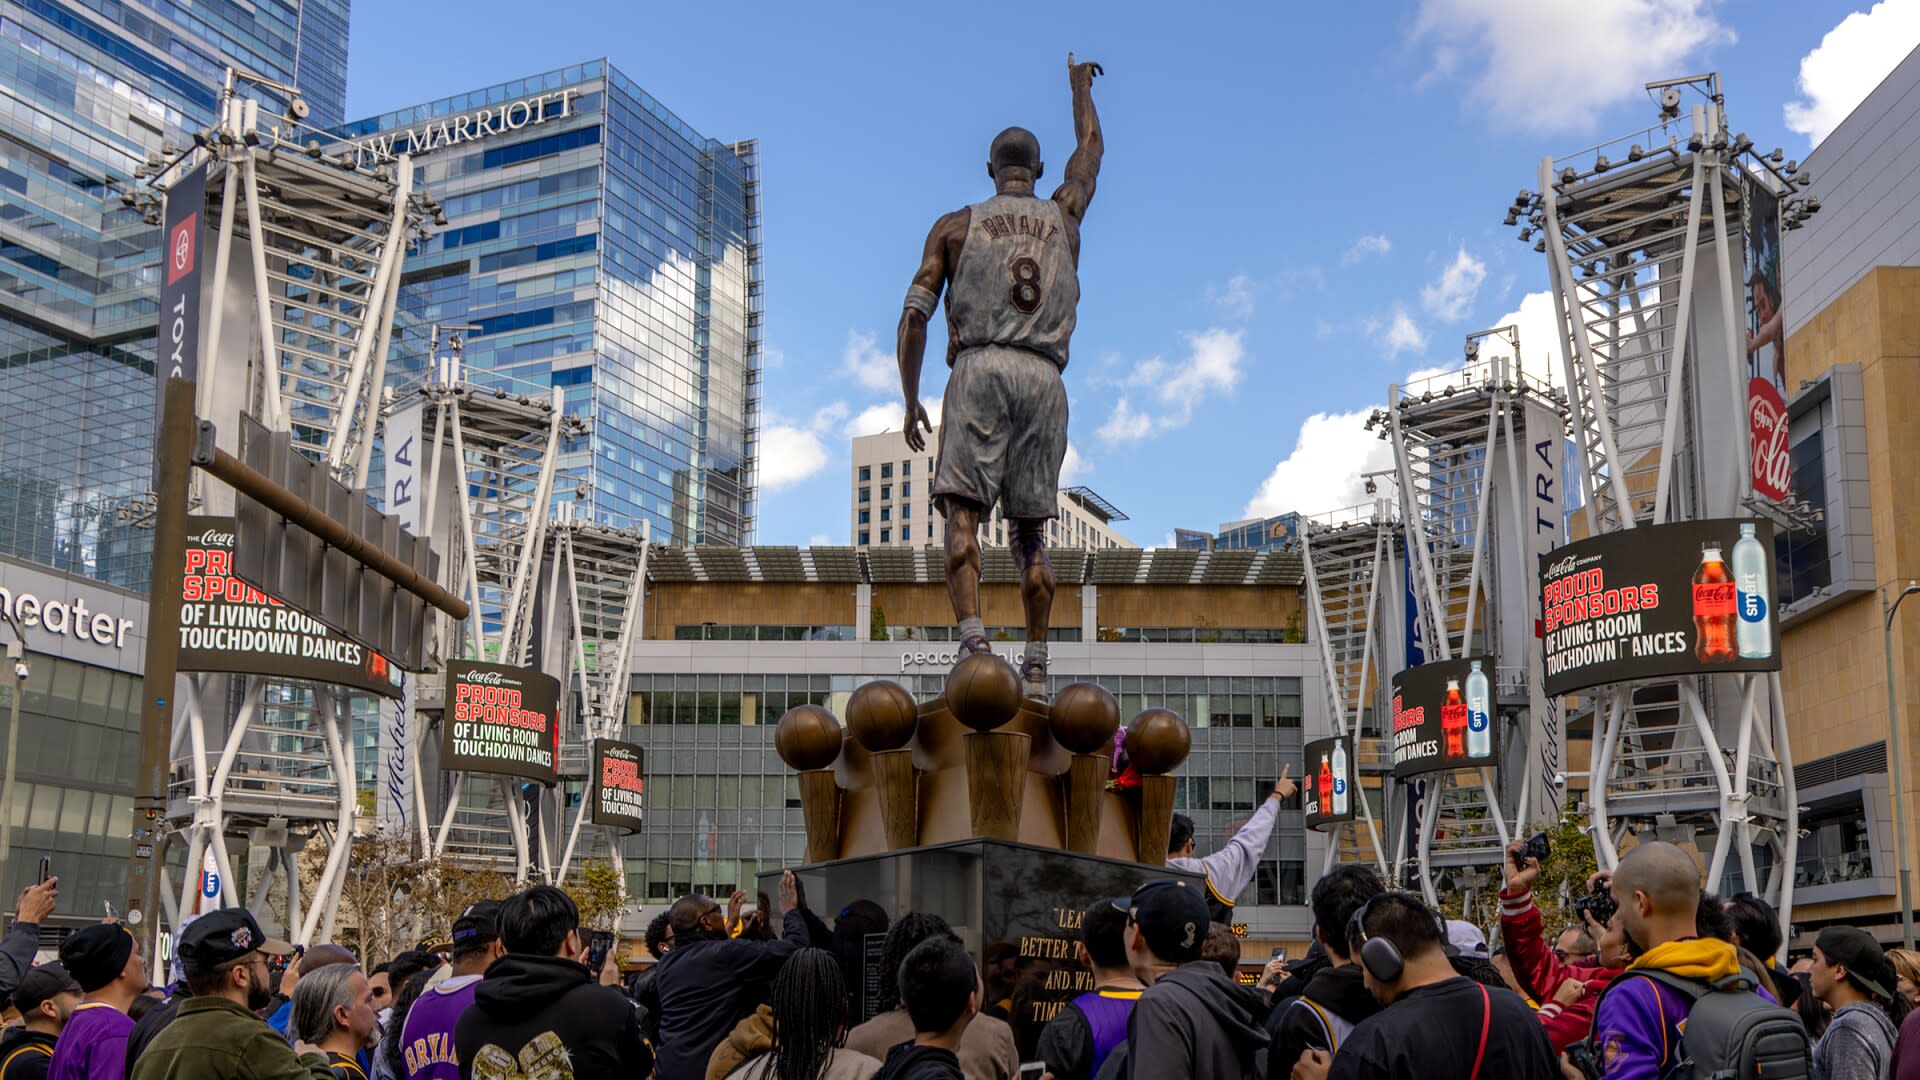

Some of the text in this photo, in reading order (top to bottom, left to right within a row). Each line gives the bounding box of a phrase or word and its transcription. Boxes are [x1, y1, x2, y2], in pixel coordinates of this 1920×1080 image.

[357, 88, 580, 169] JW MARRIOTT
[981, 214, 1060, 243] BRYANT
[1010, 256, 1043, 315] 8
[185, 549, 233, 576] PR
[1549, 554, 1577, 579] Coca-Cola
[1576, 555, 1602, 566] COMPANY
[1544, 568, 1603, 609] PROUD
[1742, 573, 1759, 617] smart
[181, 604, 205, 625] OF
[209, 605, 270, 629] LIVING
[1545, 584, 1659, 632] SPONSORS
[179, 628, 360, 665] TOUCHDOWN DANCES
[1546, 613, 1641, 655] OF LIVING ROOM
[1547, 639, 1616, 677] TOUCHDOWN
[467, 670, 503, 685] Coca-Cola
[456, 683, 521, 708] PROUD
[455, 703, 546, 732] SPONSORS
[1471, 697, 1482, 728] smart
[453, 722, 539, 747] OF LIVING ROOM
[453, 739, 552, 767] TOUCHDOWN DANCES
[1407, 740, 1437, 760] DANCES
[602, 788, 613, 801] OF
[1019, 936, 1068, 959] BETTER
[1045, 970, 1070, 990] AND
